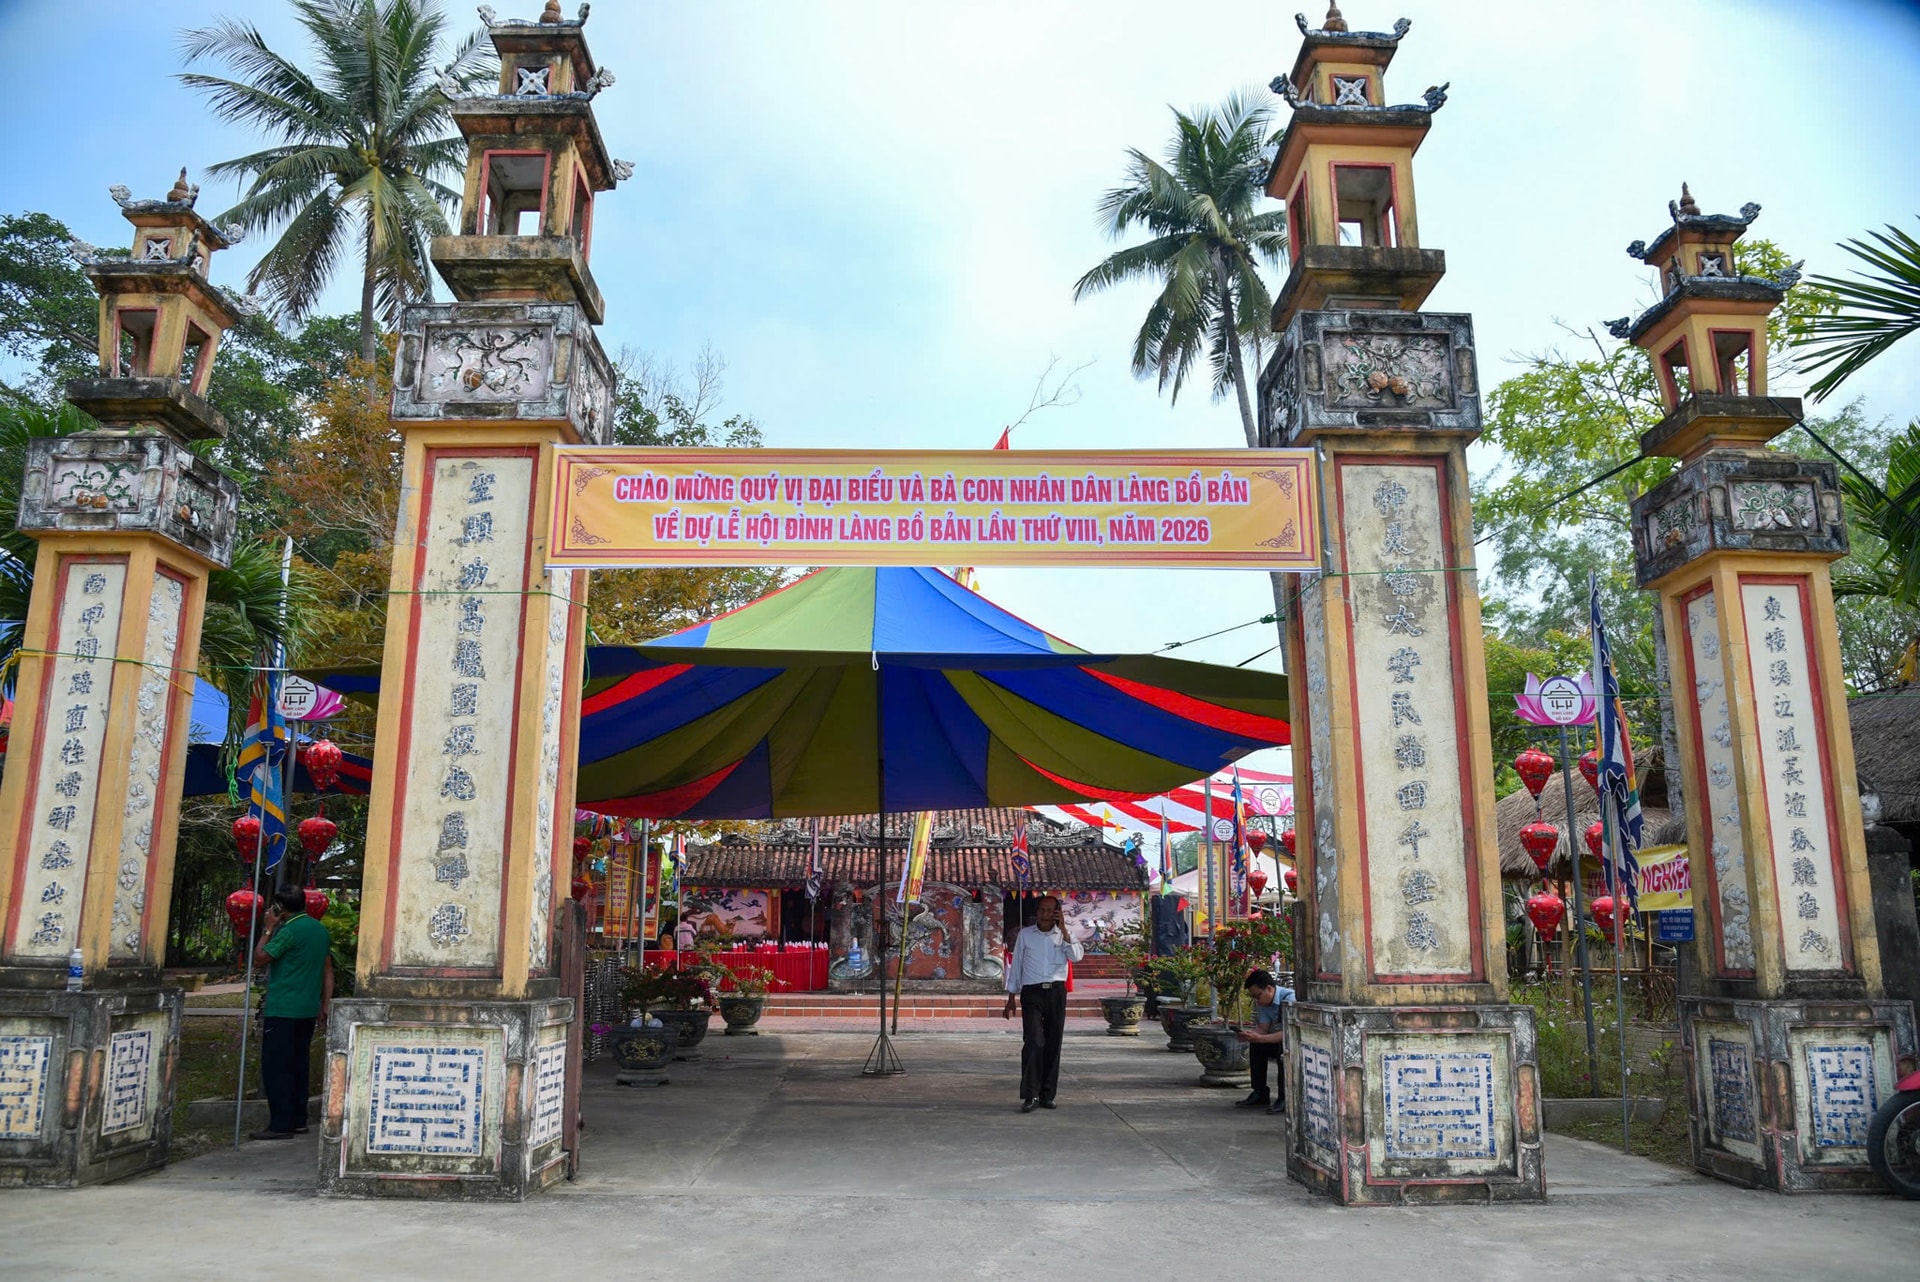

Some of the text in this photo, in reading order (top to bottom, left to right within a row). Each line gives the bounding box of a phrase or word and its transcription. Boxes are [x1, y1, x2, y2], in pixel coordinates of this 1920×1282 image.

[616, 469, 1249, 507] CHÀO MỪNG QUÝ VỊ ĐẠI BIỂU VÀ BÀ CON NHÂN DÂN LÀNG BỒ BẢN
[655, 507, 1209, 545] VỀ DỰ LỄ HỘI ĐÌNH LÀNG BỒ BẢN LẦN THỨ VIII, NĂM 2026
